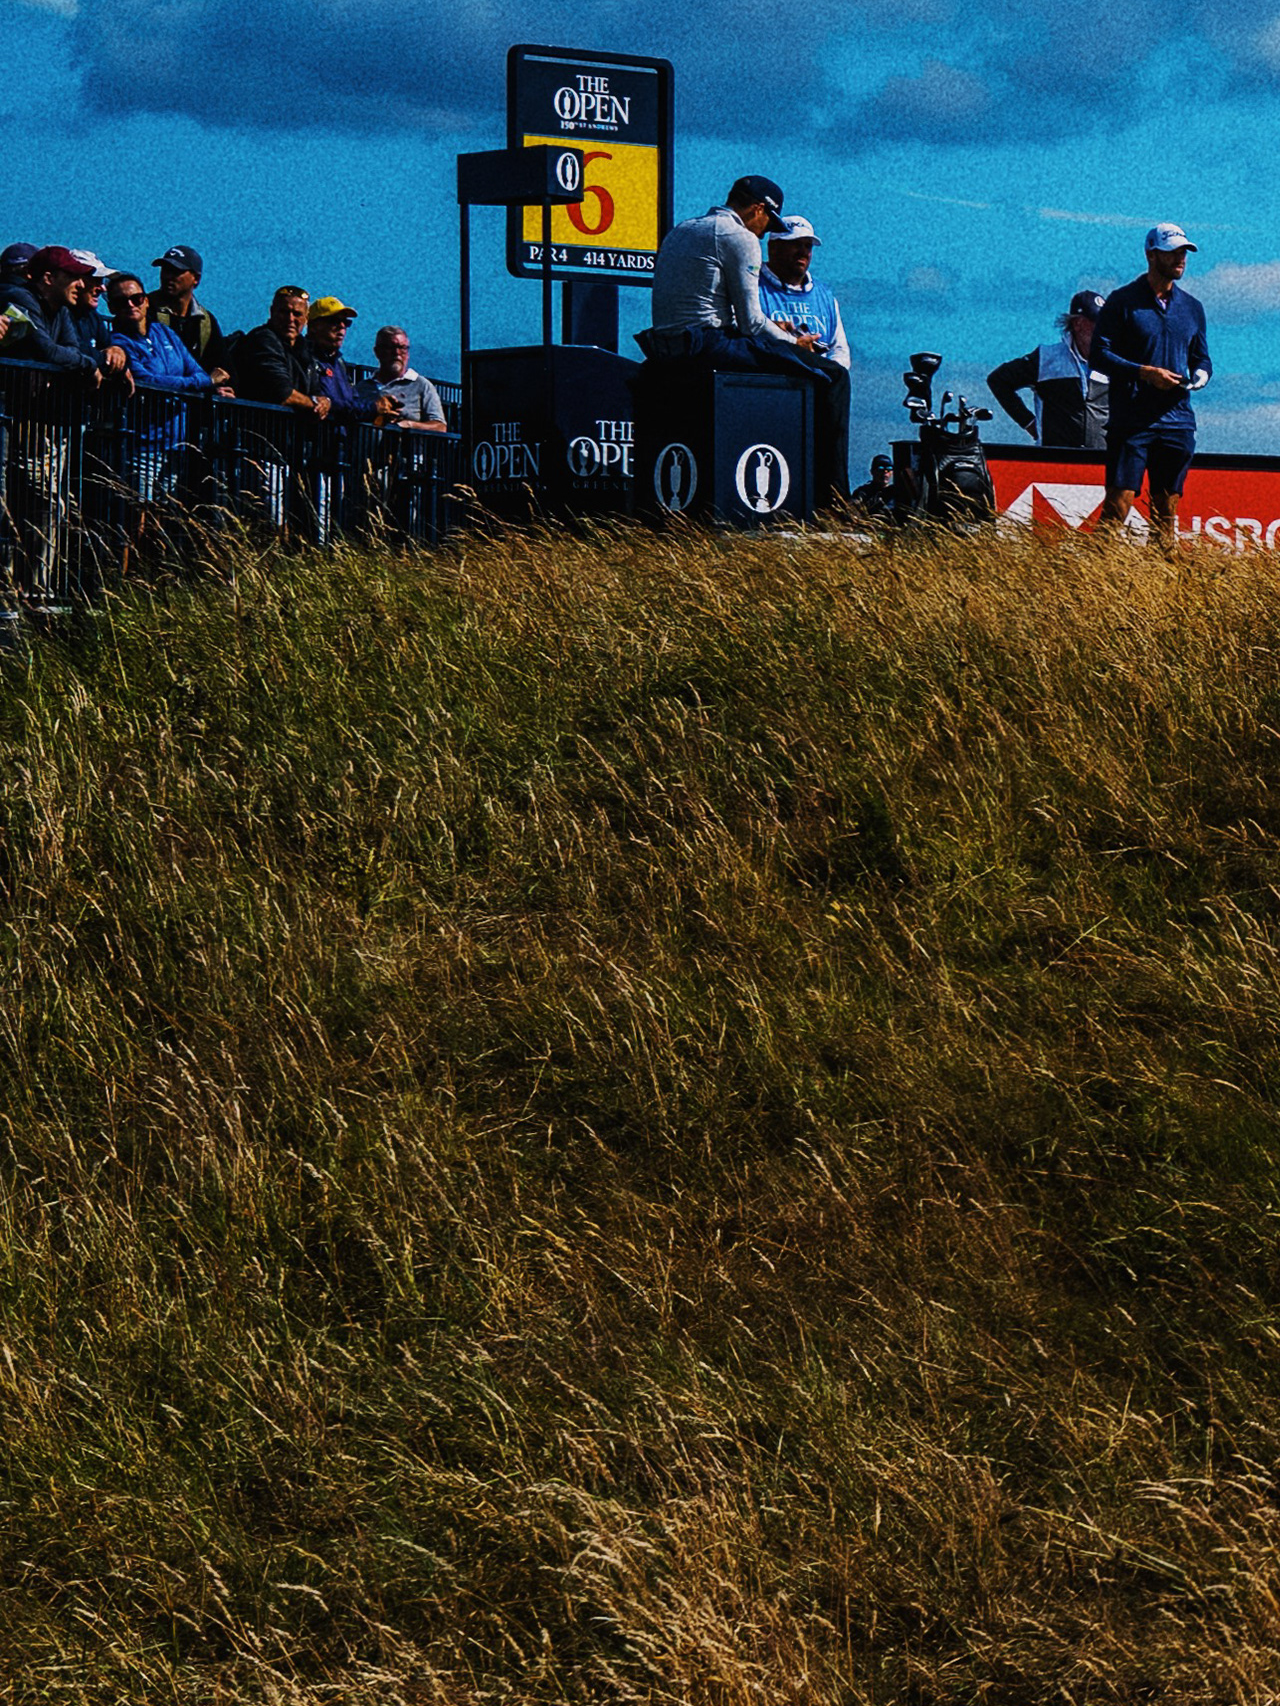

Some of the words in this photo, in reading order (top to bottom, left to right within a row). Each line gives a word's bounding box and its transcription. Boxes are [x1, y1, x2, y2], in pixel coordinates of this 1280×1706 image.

[576, 75, 609, 94] THE
[554, 87, 631, 125] OPEN
[566, 151, 615, 236] 6
[559, 249, 568, 262] 4
[584, 251, 605, 266] 414
[607, 253, 655, 270] YARDS
[492, 422, 520, 443] THE
[473, 440, 541, 481] OPEN
[567, 436, 634, 477] OPE
